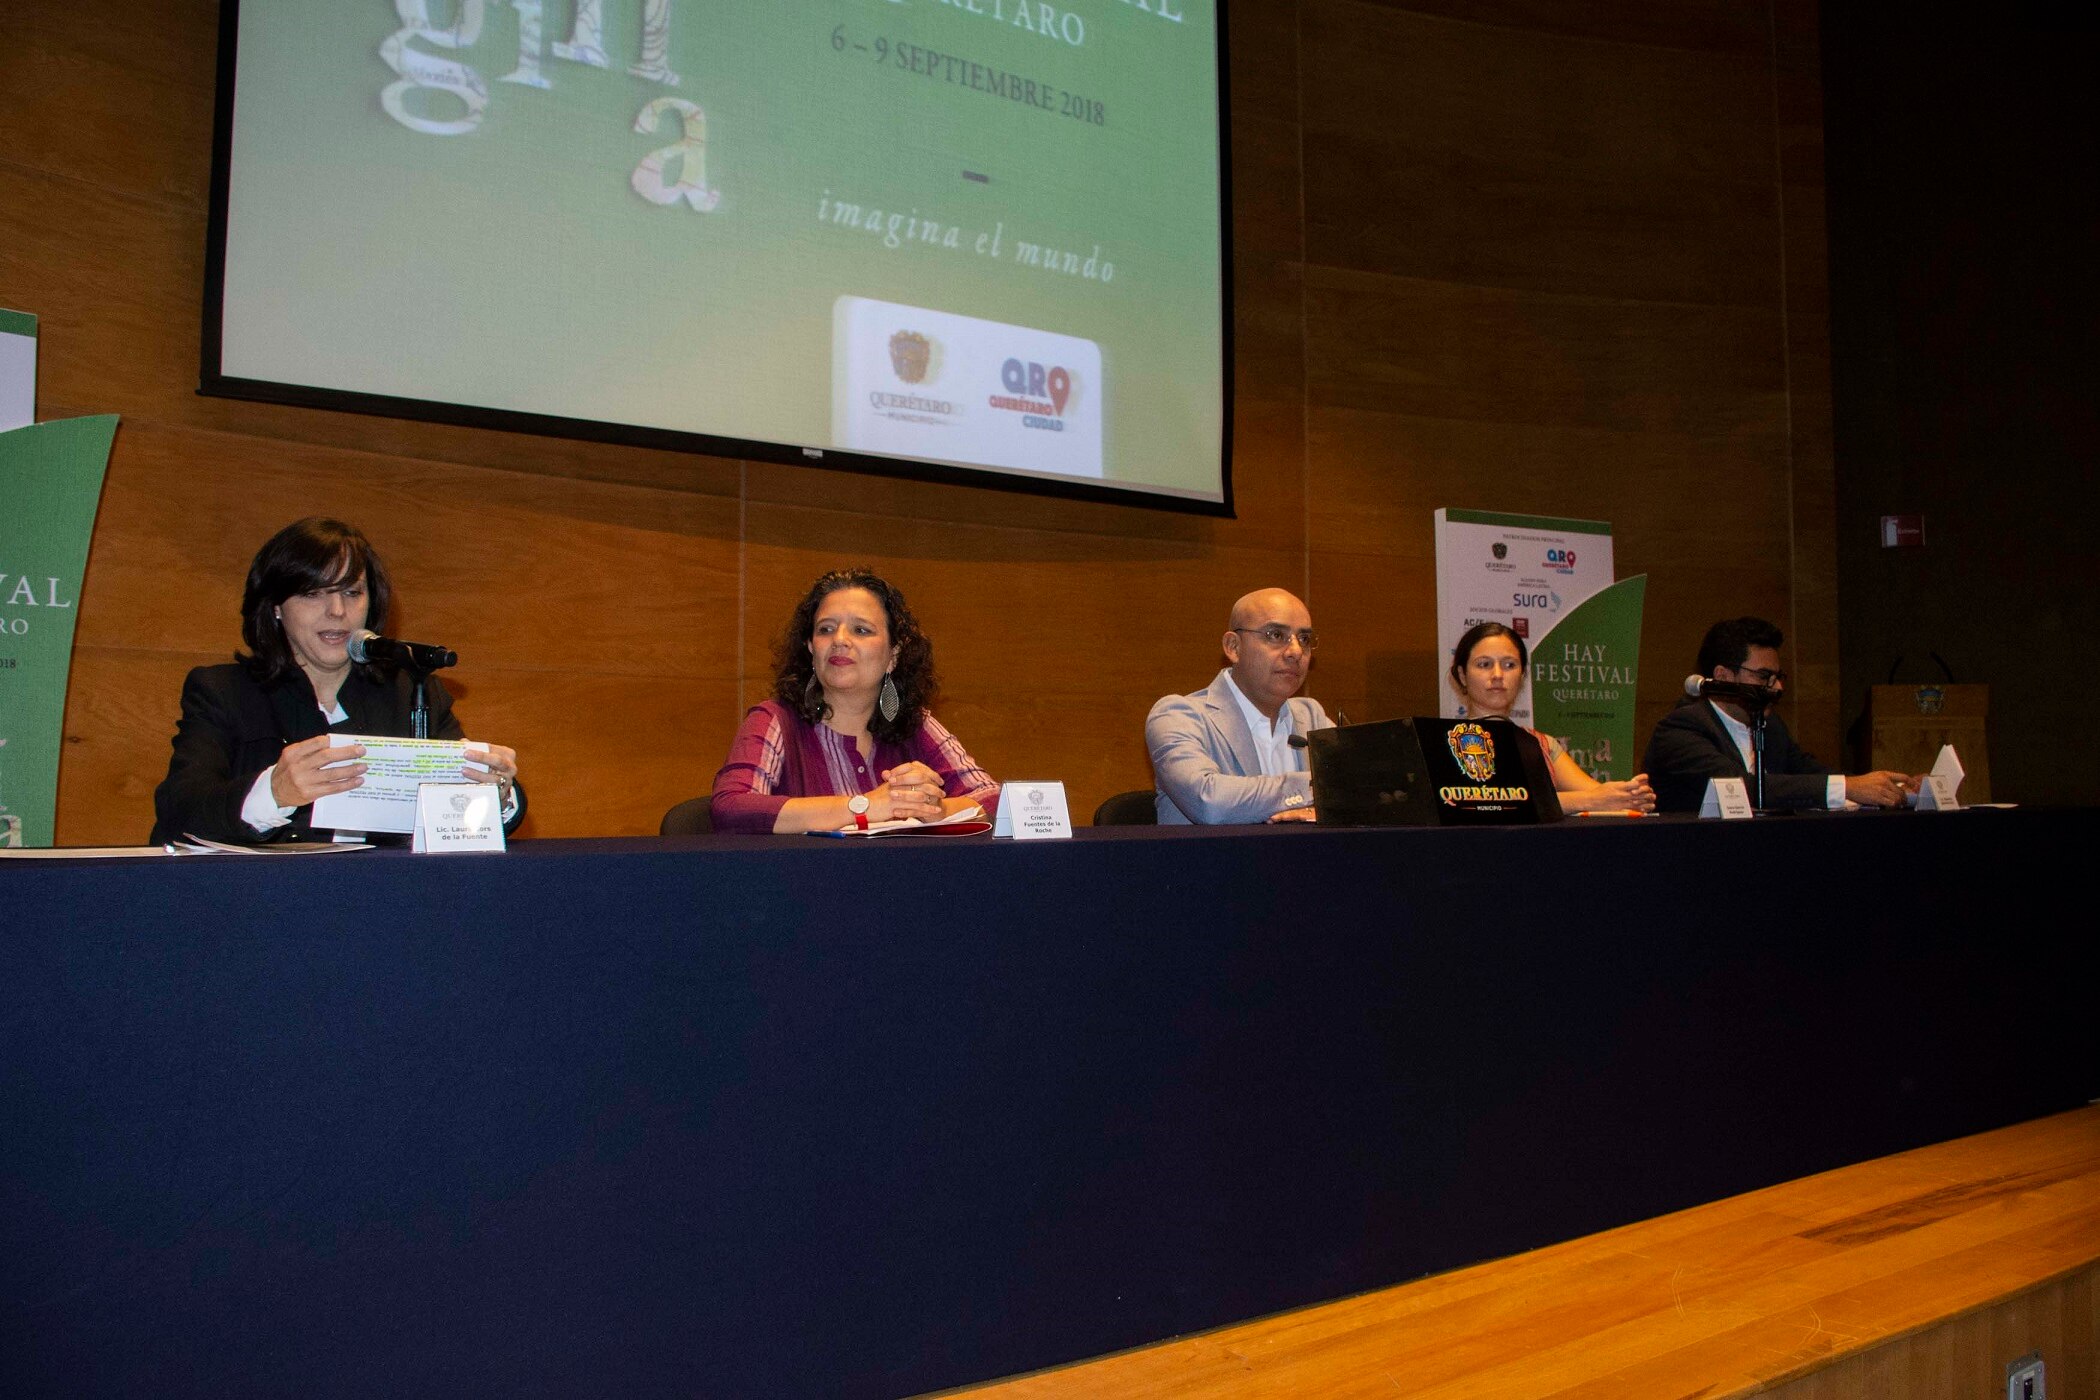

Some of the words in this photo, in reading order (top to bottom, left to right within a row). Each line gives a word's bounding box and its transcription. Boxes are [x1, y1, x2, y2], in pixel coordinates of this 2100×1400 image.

[831, 24, 846, 51] 6
[875, 36, 889, 64] 9
[897, 41, 1054, 111] SEPTIEMBRE
[1061, 91, 1106, 127] 2018
[817, 189, 960, 249] imagina
[975, 222, 1004, 259] el
[1016, 240, 1115, 283] mundo
[1022, 415, 1064, 432] CIUDAD
[1513, 593, 1547, 608] sura
[1564, 644, 1607, 663] HAY
[1536, 664, 1635, 685] FESTIVAL
[1553, 687, 1619, 702] QUERÉTARO
[1440, 785, 1529, 806] QUERÉTARO
